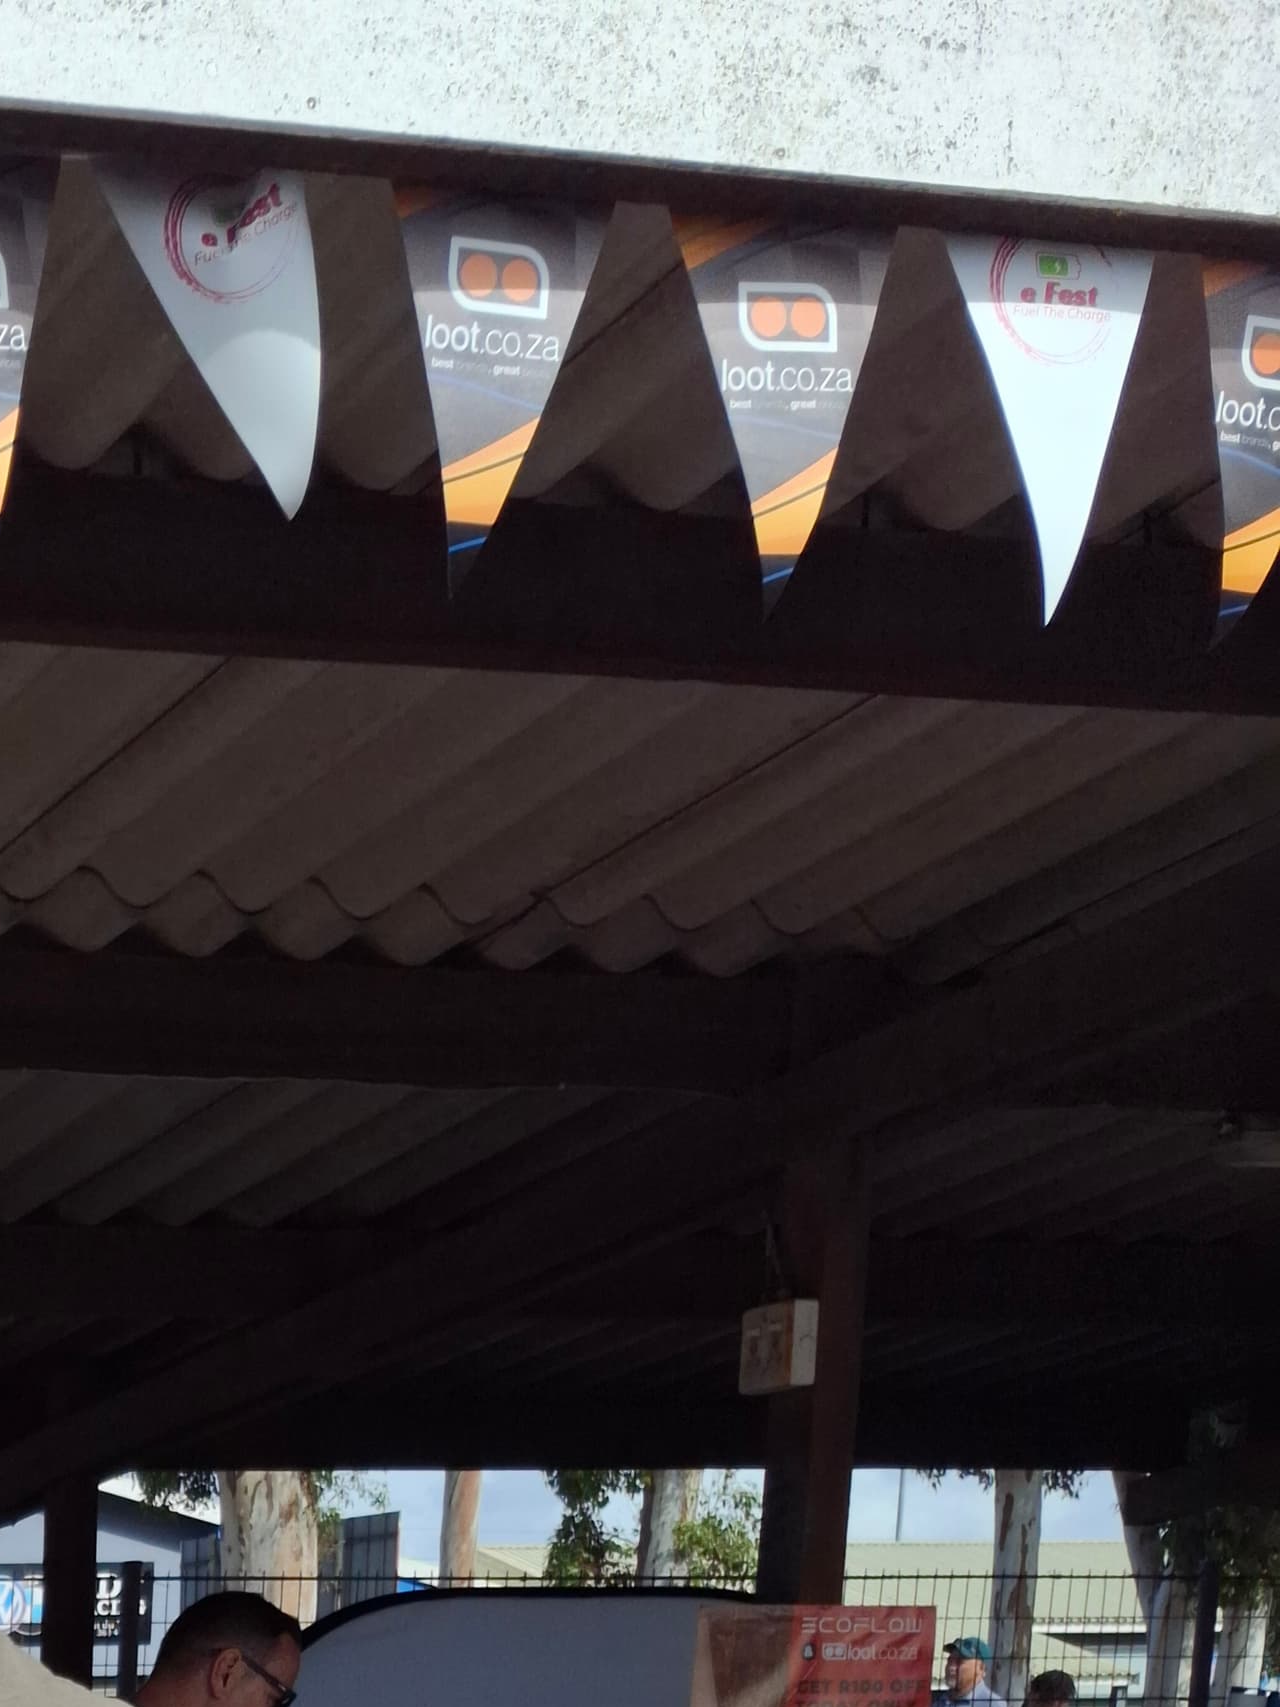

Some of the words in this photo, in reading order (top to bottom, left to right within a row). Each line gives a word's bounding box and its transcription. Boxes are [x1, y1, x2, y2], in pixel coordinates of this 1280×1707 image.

[424, 314, 560, 362] loot.co.za
[721, 358, 854, 392] loot.co.za
[802, 1616, 923, 1634] ECOFLOW
